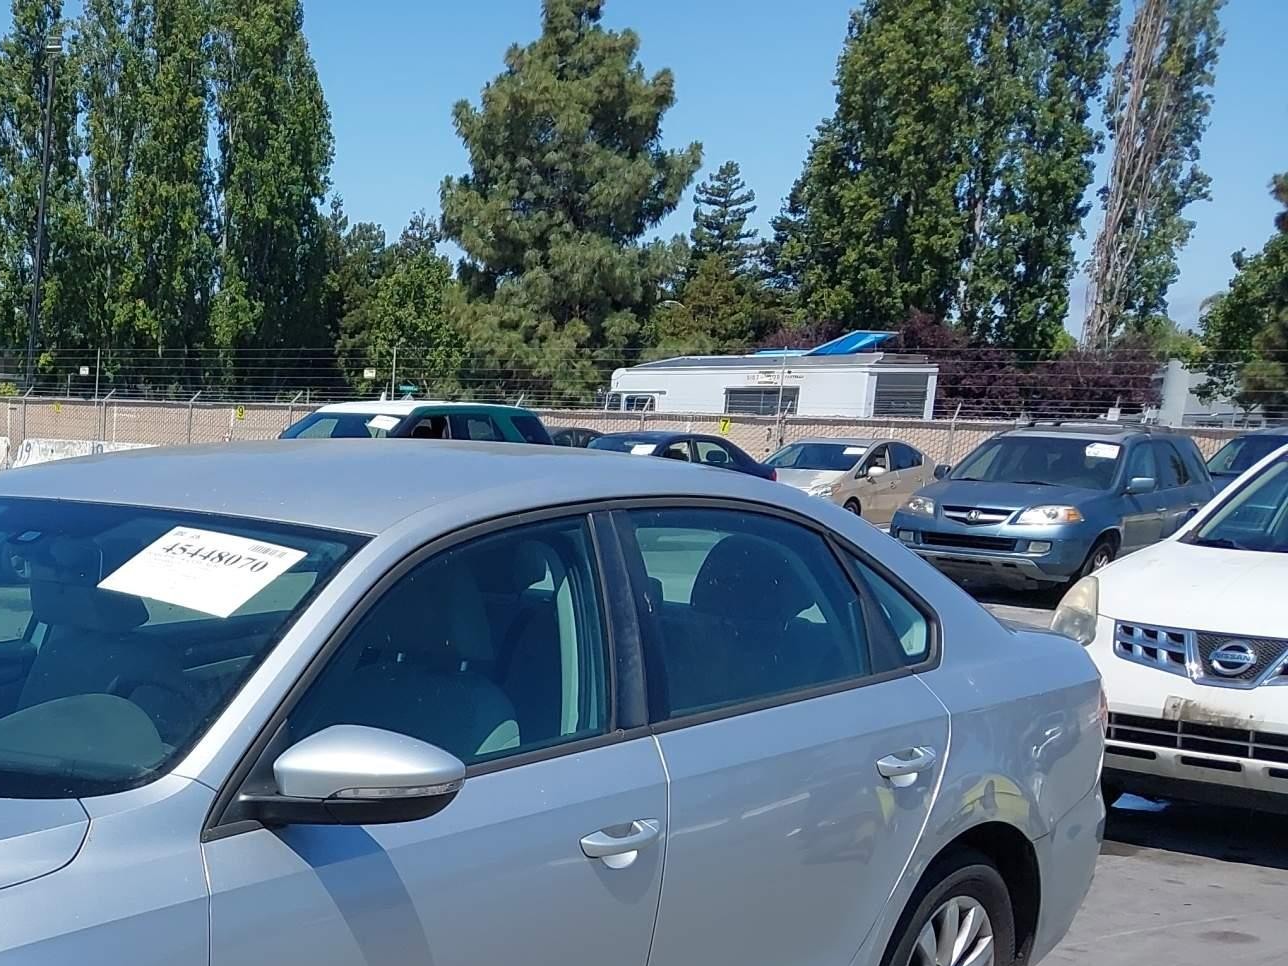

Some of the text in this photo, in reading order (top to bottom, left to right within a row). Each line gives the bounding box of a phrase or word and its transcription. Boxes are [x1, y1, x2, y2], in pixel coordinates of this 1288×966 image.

[17, 442, 32, 464] 19
[162, 542, 269, 573] 45448070
[1213, 652, 1251, 662] NISSAN
